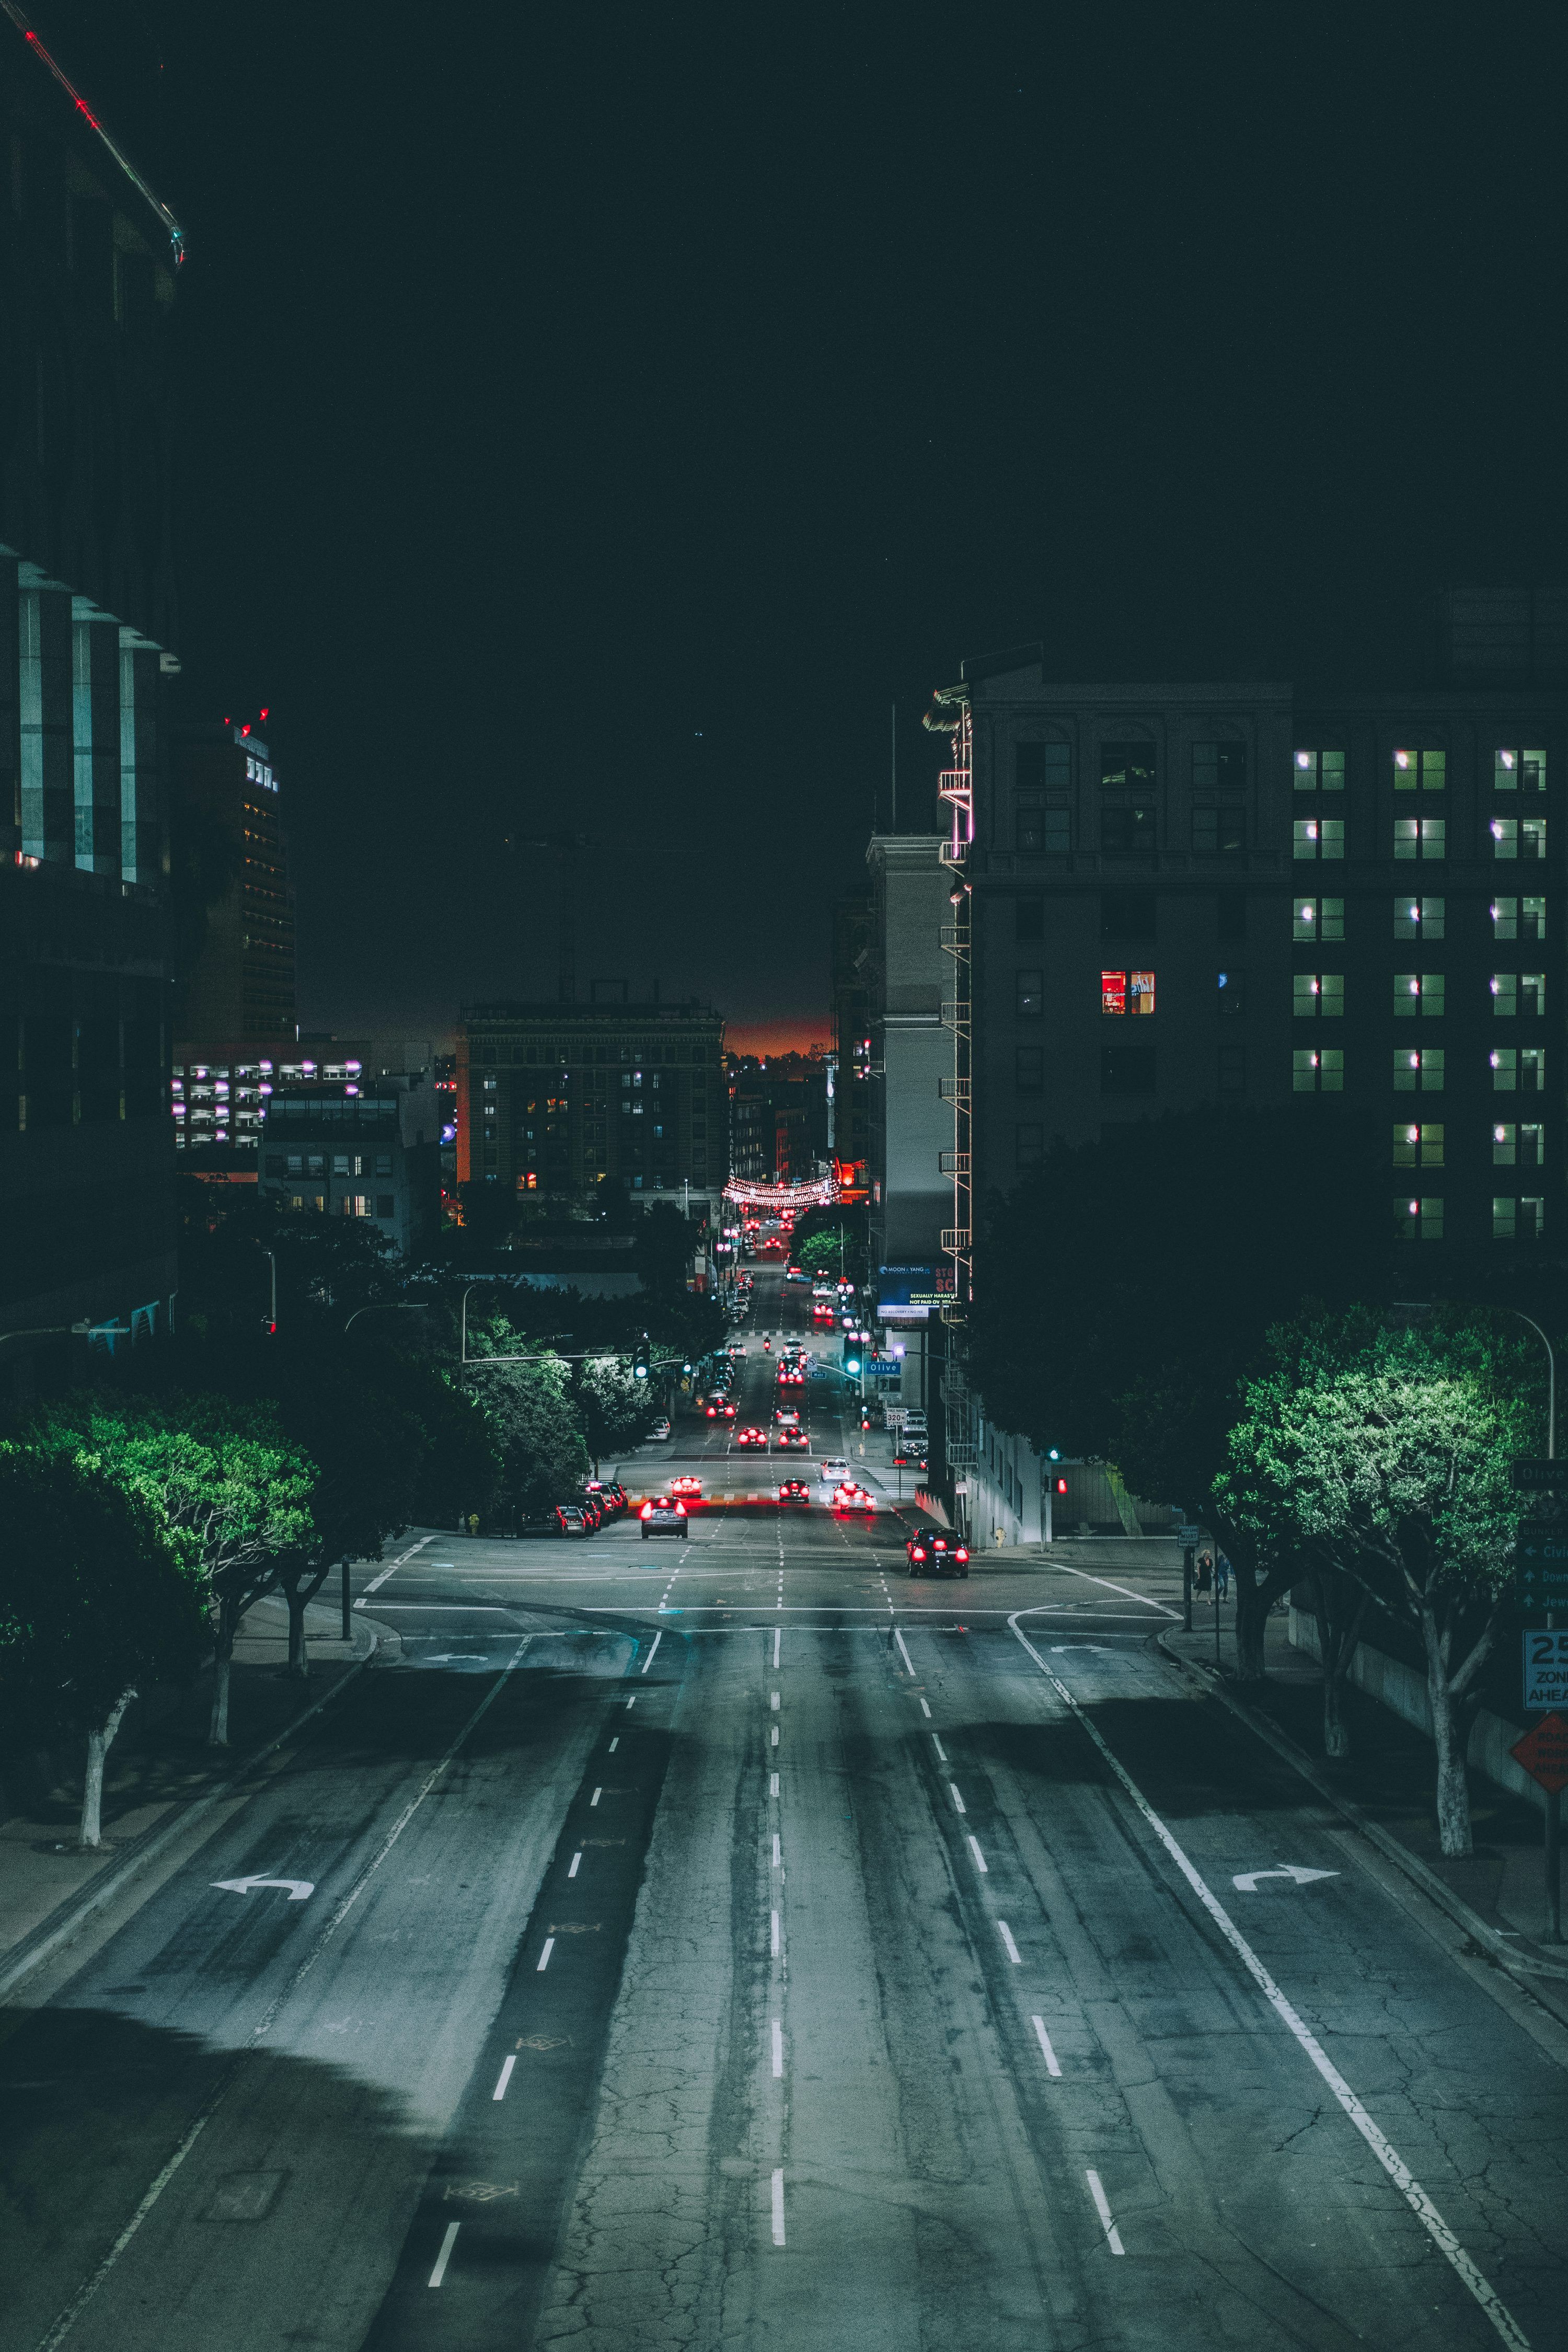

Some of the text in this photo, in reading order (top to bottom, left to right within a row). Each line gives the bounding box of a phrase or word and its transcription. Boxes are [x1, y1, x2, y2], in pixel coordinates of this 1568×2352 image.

[1523, 1467, 1564, 1480] Olive
[1523, 1527, 1564, 1535] BUNKER
[1543, 1545, 1568, 1558] Civi
[1536, 1671, 1568, 1684] ZON
